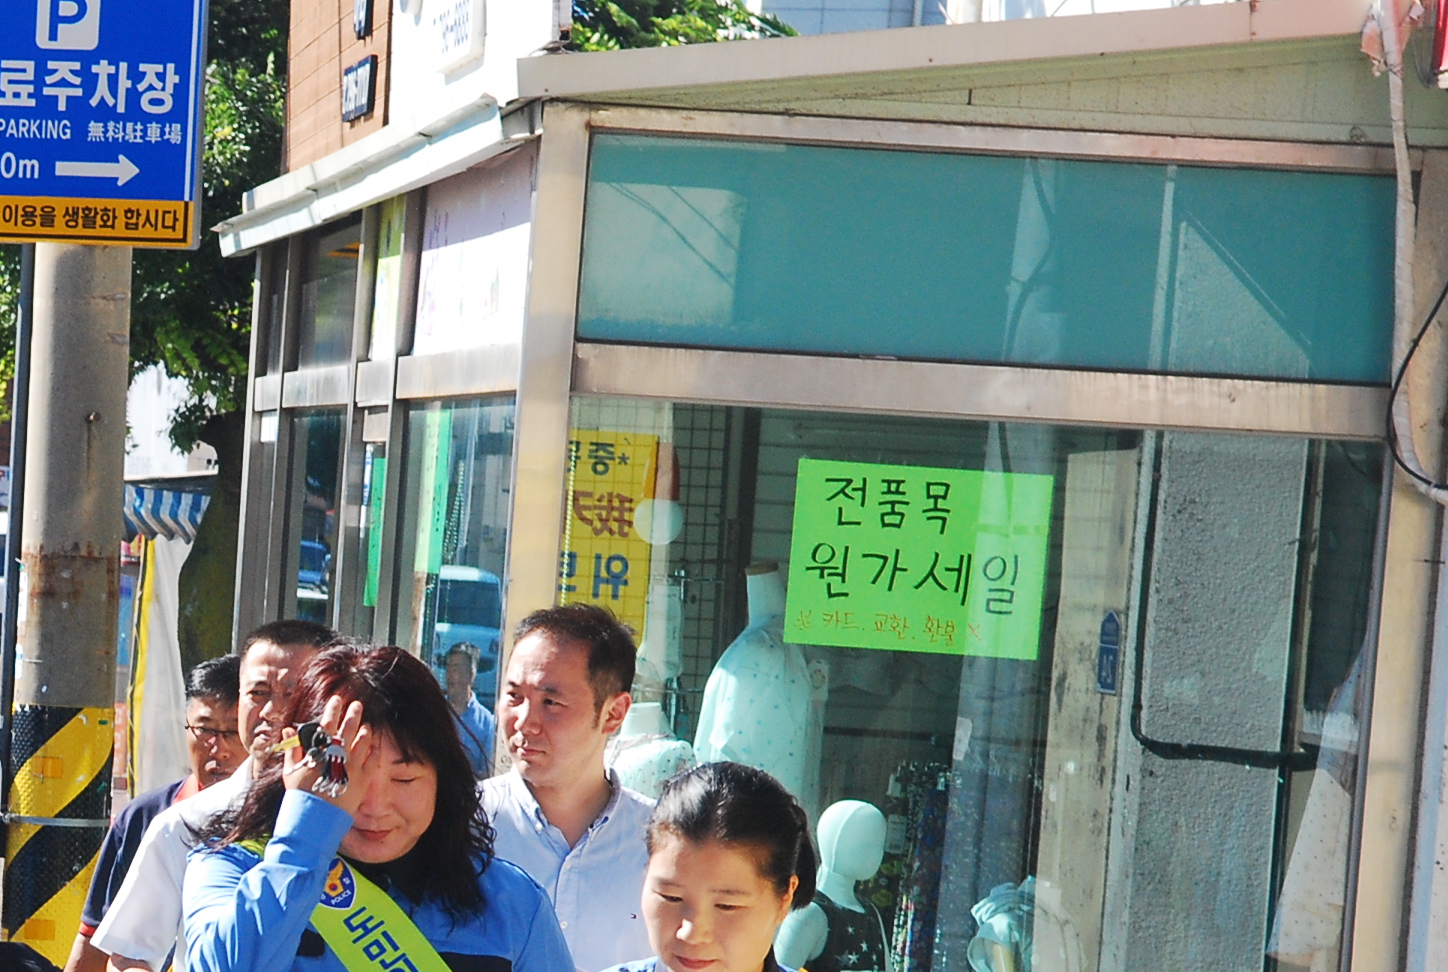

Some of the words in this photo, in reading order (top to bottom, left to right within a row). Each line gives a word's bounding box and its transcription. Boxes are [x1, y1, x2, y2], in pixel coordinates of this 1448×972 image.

[48, 0, 88, 42] P
[87, 120, 182, 145] 無料駐車場
[2, 204, 56, 228] 이용을
[62, 206, 117, 230] 생활화
[123, 207, 179, 232] 합시다
[824, 476, 952, 535] 전품목
[331, 889, 352, 905] POLICE
